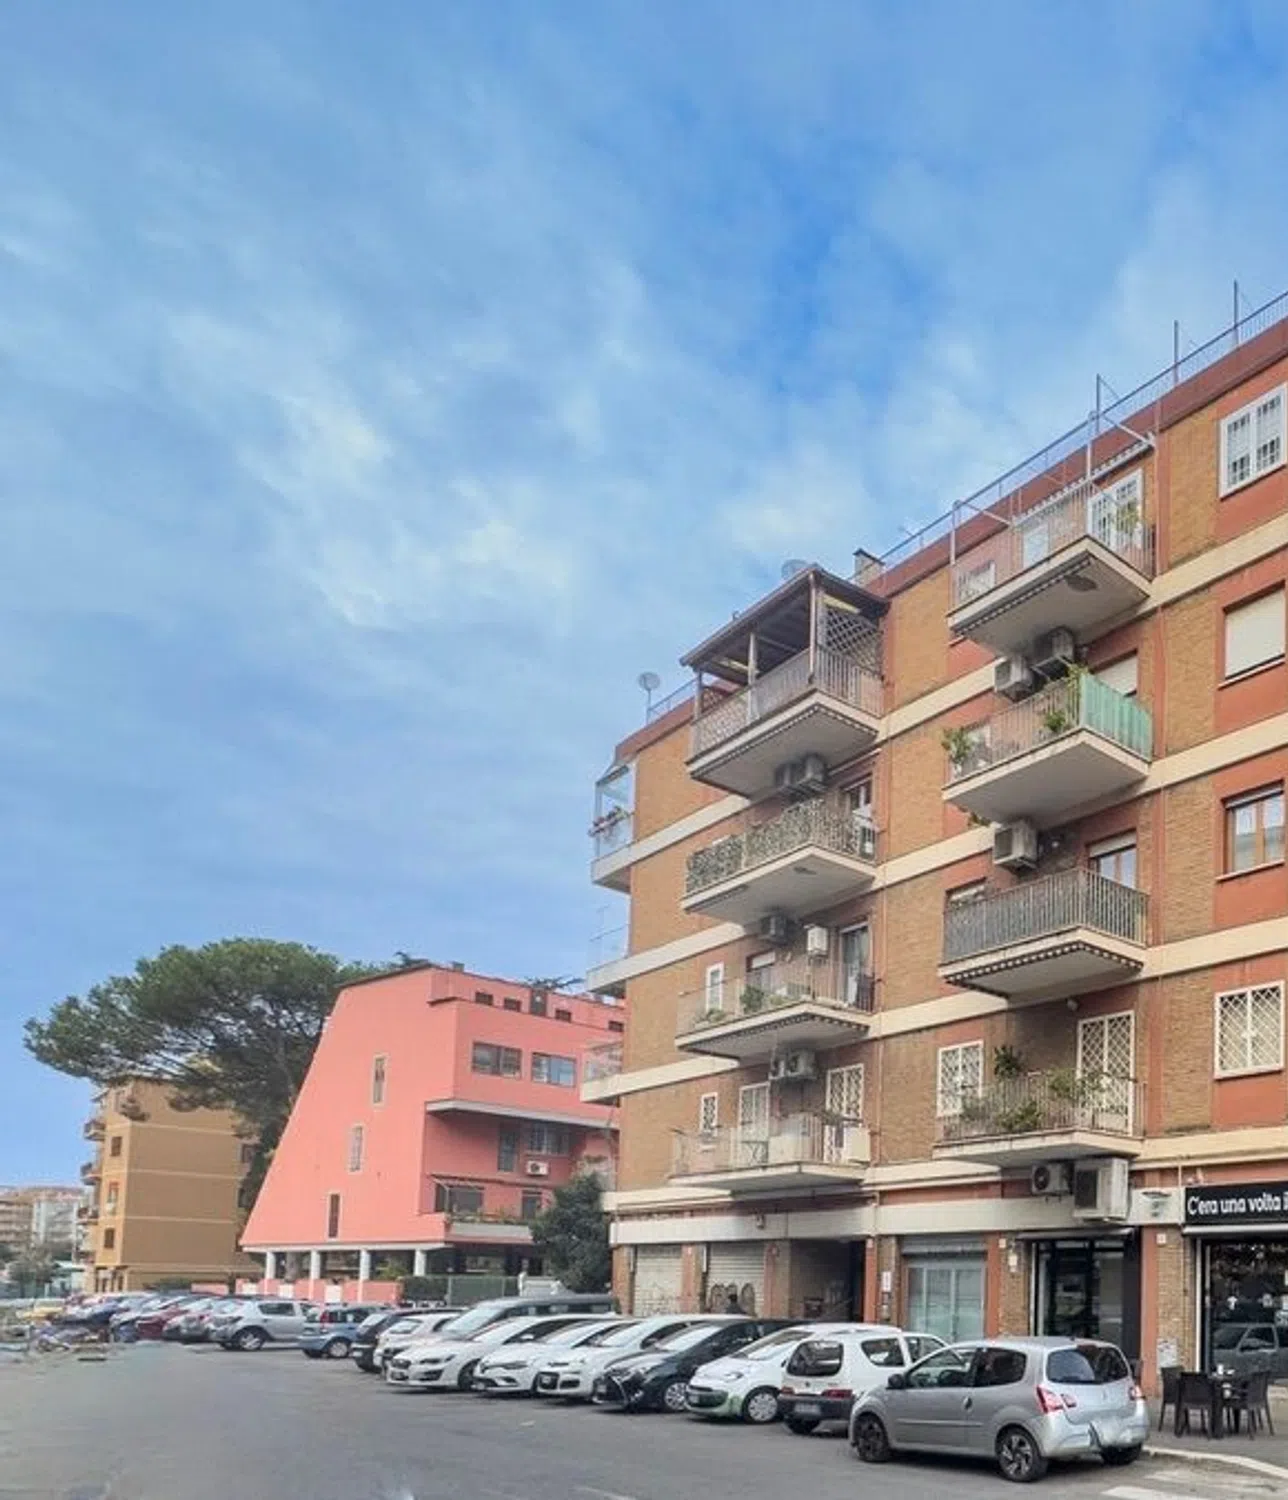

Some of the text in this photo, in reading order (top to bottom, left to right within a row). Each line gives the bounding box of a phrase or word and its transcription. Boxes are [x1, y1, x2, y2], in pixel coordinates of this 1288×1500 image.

[1187, 1195, 1218, 1215] C'era
[1220, 1198, 1247, 1214] una
[1248, 1191, 1282, 1212] volta
